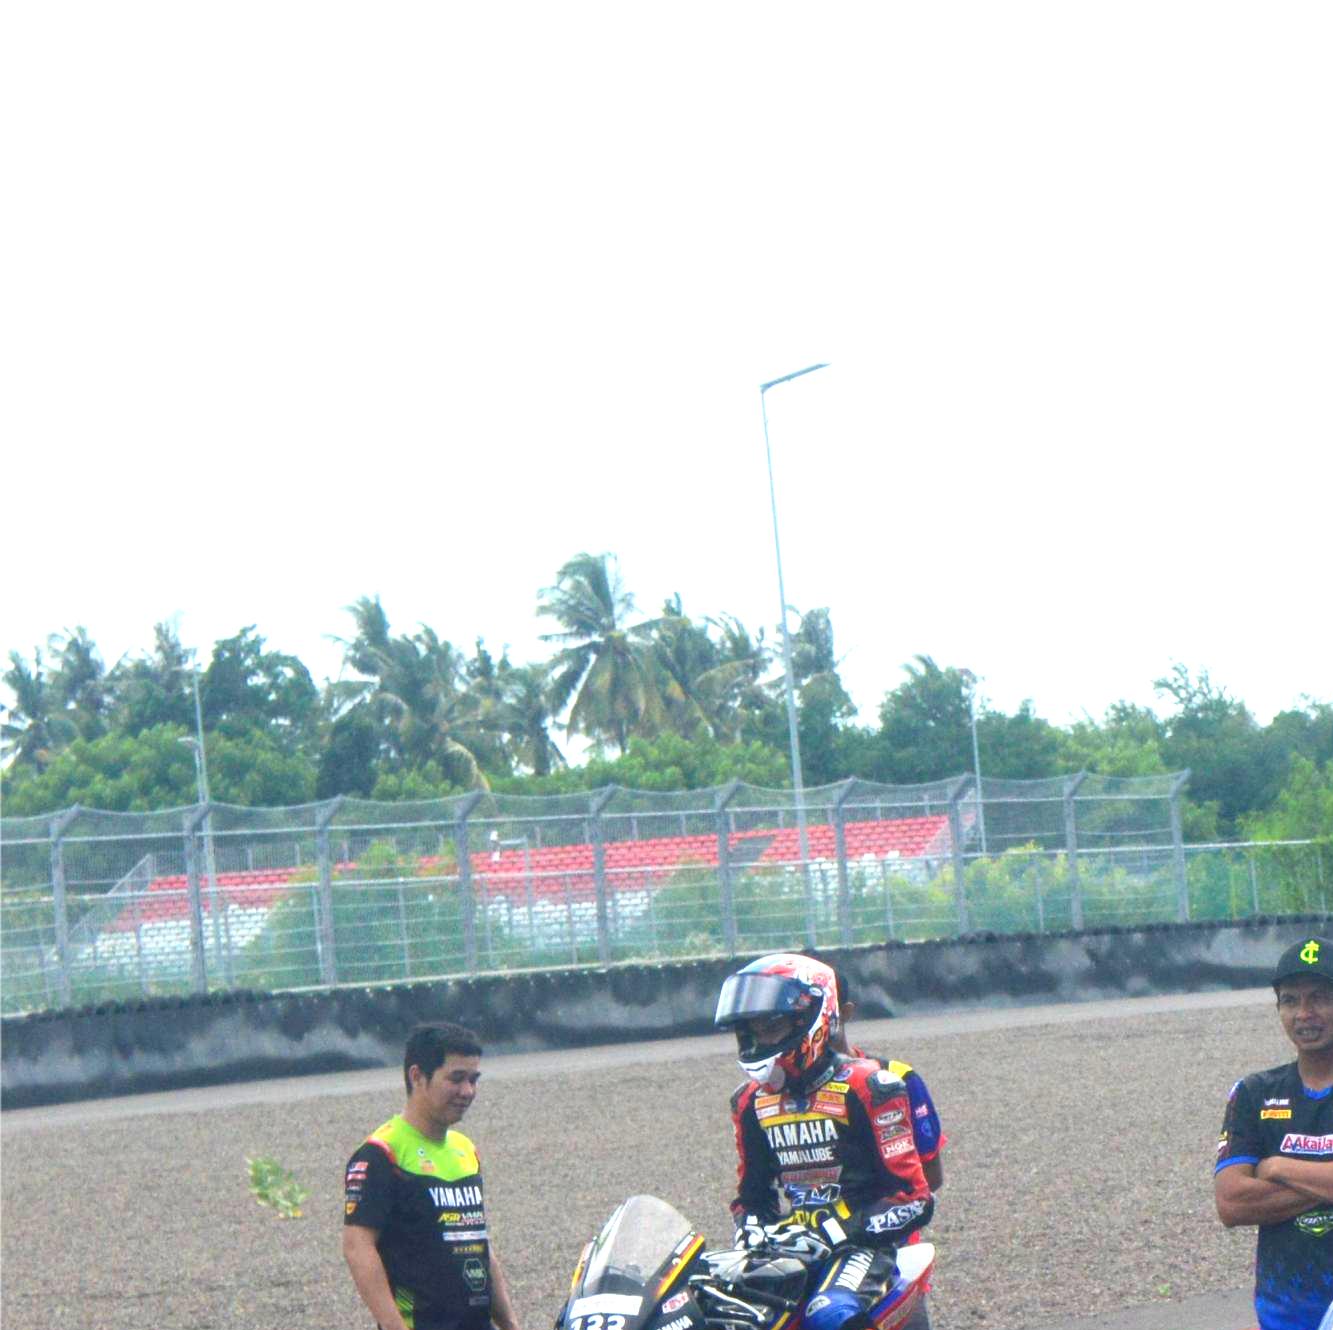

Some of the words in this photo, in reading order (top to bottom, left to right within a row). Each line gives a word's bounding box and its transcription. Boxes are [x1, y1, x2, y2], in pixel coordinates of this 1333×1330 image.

[765, 1119, 839, 1148] YAMAHA
[776, 1146, 834, 1166] YAMALUBE
[428, 1186, 483, 1207] YAMAHA
